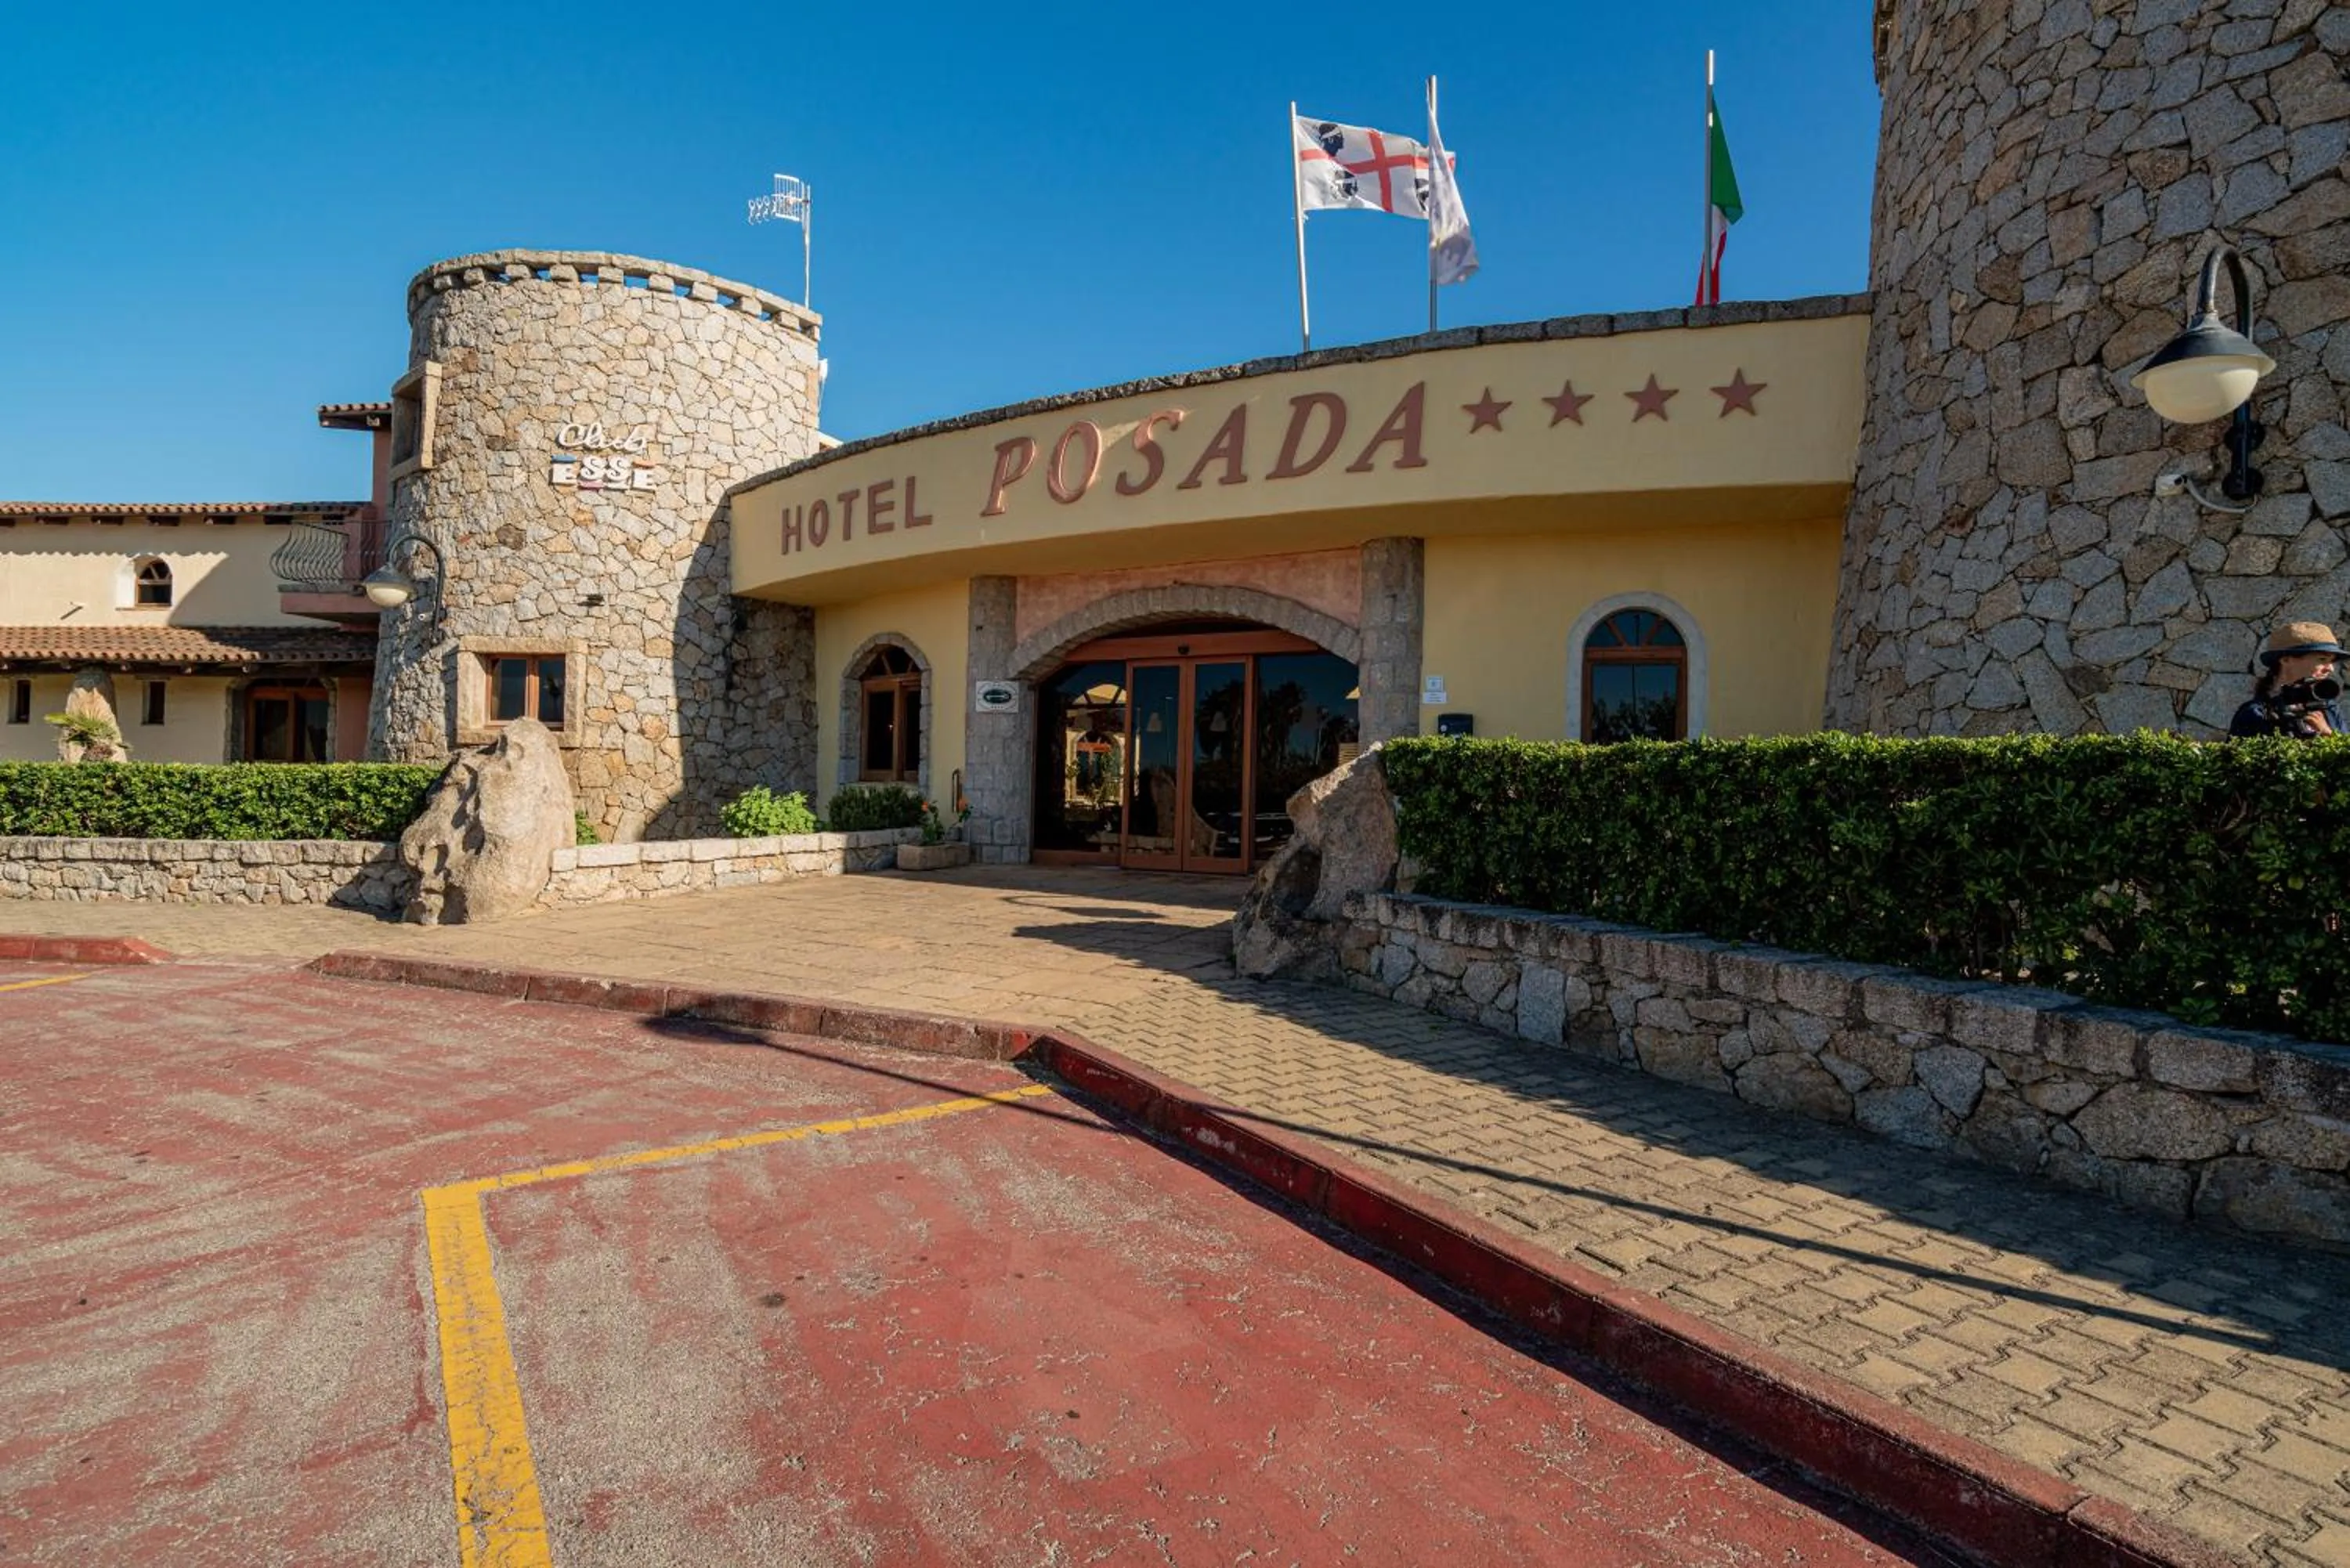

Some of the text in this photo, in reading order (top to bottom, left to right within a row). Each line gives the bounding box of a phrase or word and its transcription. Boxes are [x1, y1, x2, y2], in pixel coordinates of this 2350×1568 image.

[555, 421, 647, 453] Club
[550, 453, 656, 493] ESSE
[781, 380, 1428, 555] HOTEL POSADA
